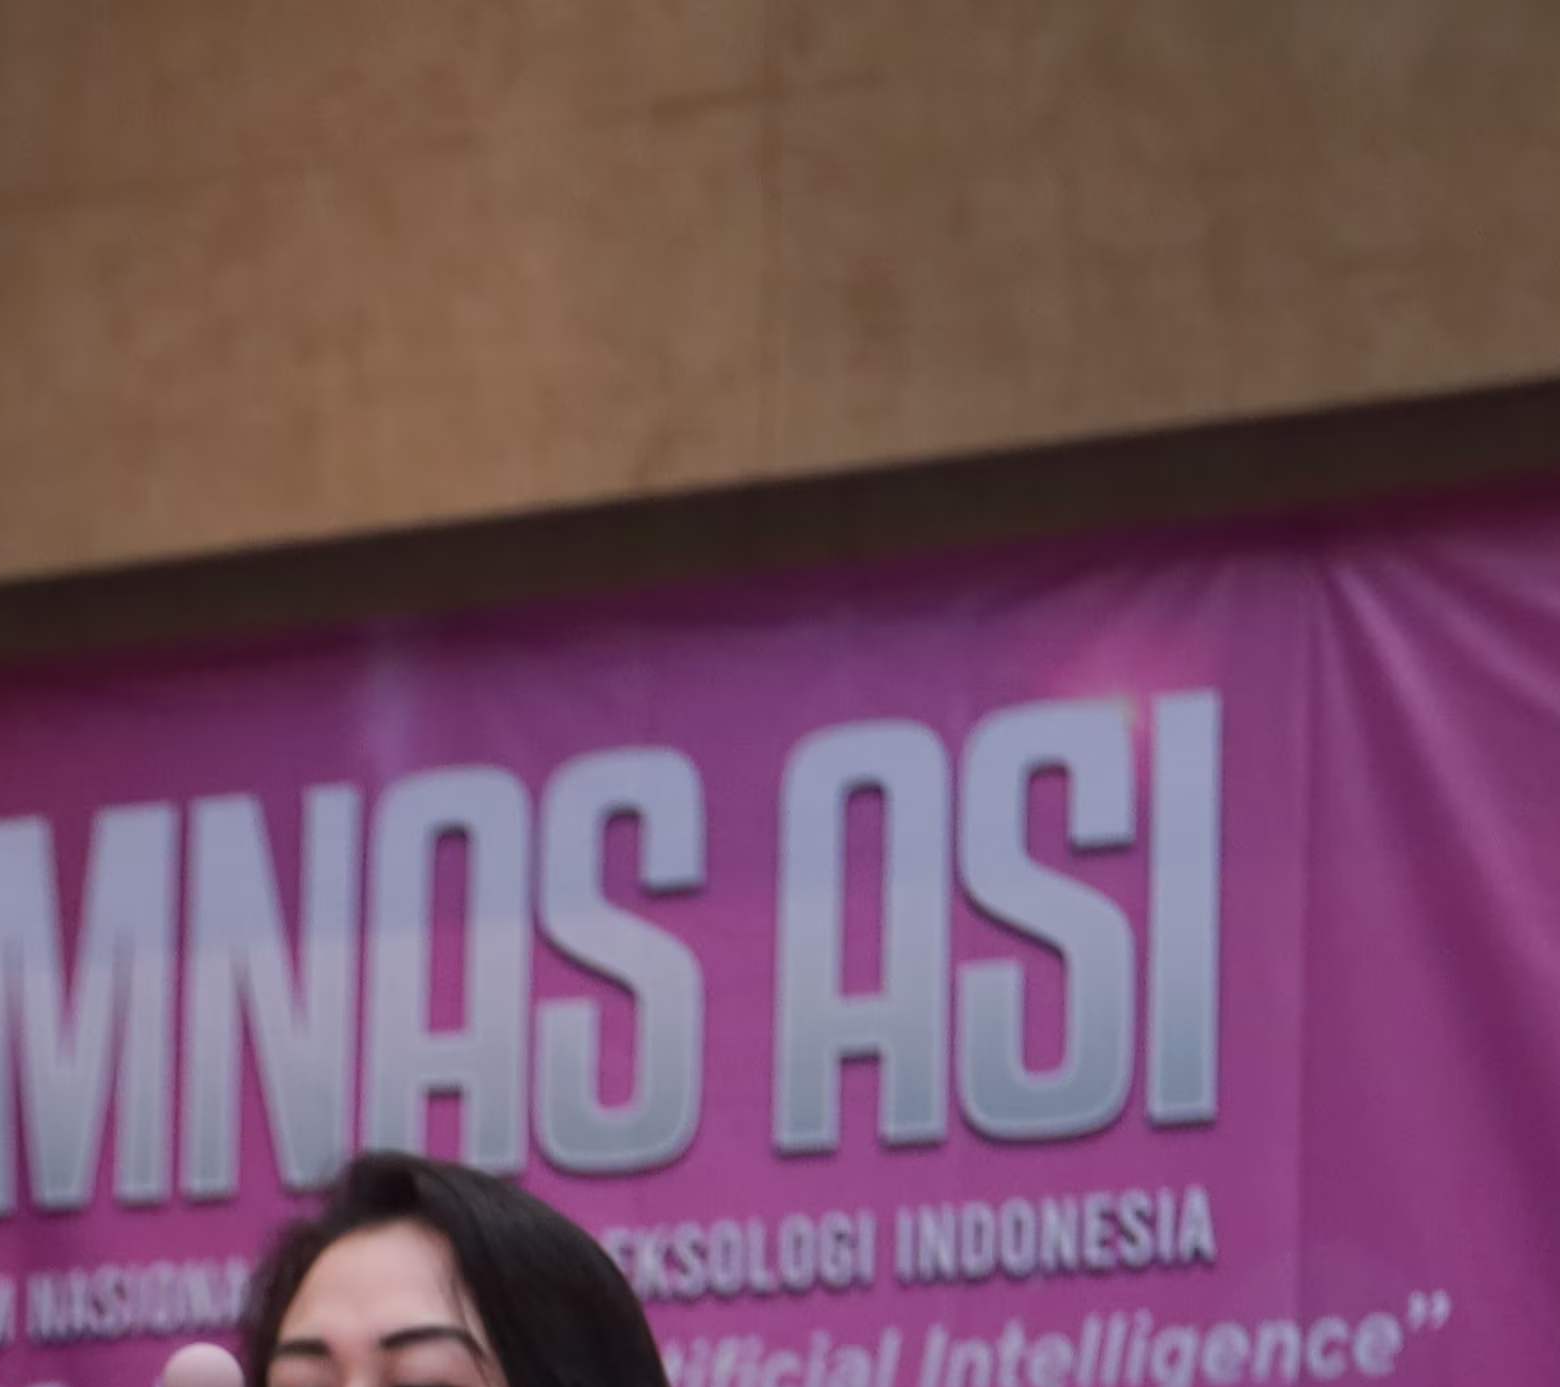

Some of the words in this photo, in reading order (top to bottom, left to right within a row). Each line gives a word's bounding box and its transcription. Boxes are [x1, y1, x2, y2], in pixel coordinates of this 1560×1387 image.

[775, 692, 1220, 1153] ASI
[28, 1261, 254, 1340] NASIONA
[599, 1213, 876, 1299] EKSOLOGI
[895, 1190, 1216, 1284] INDONESIA
